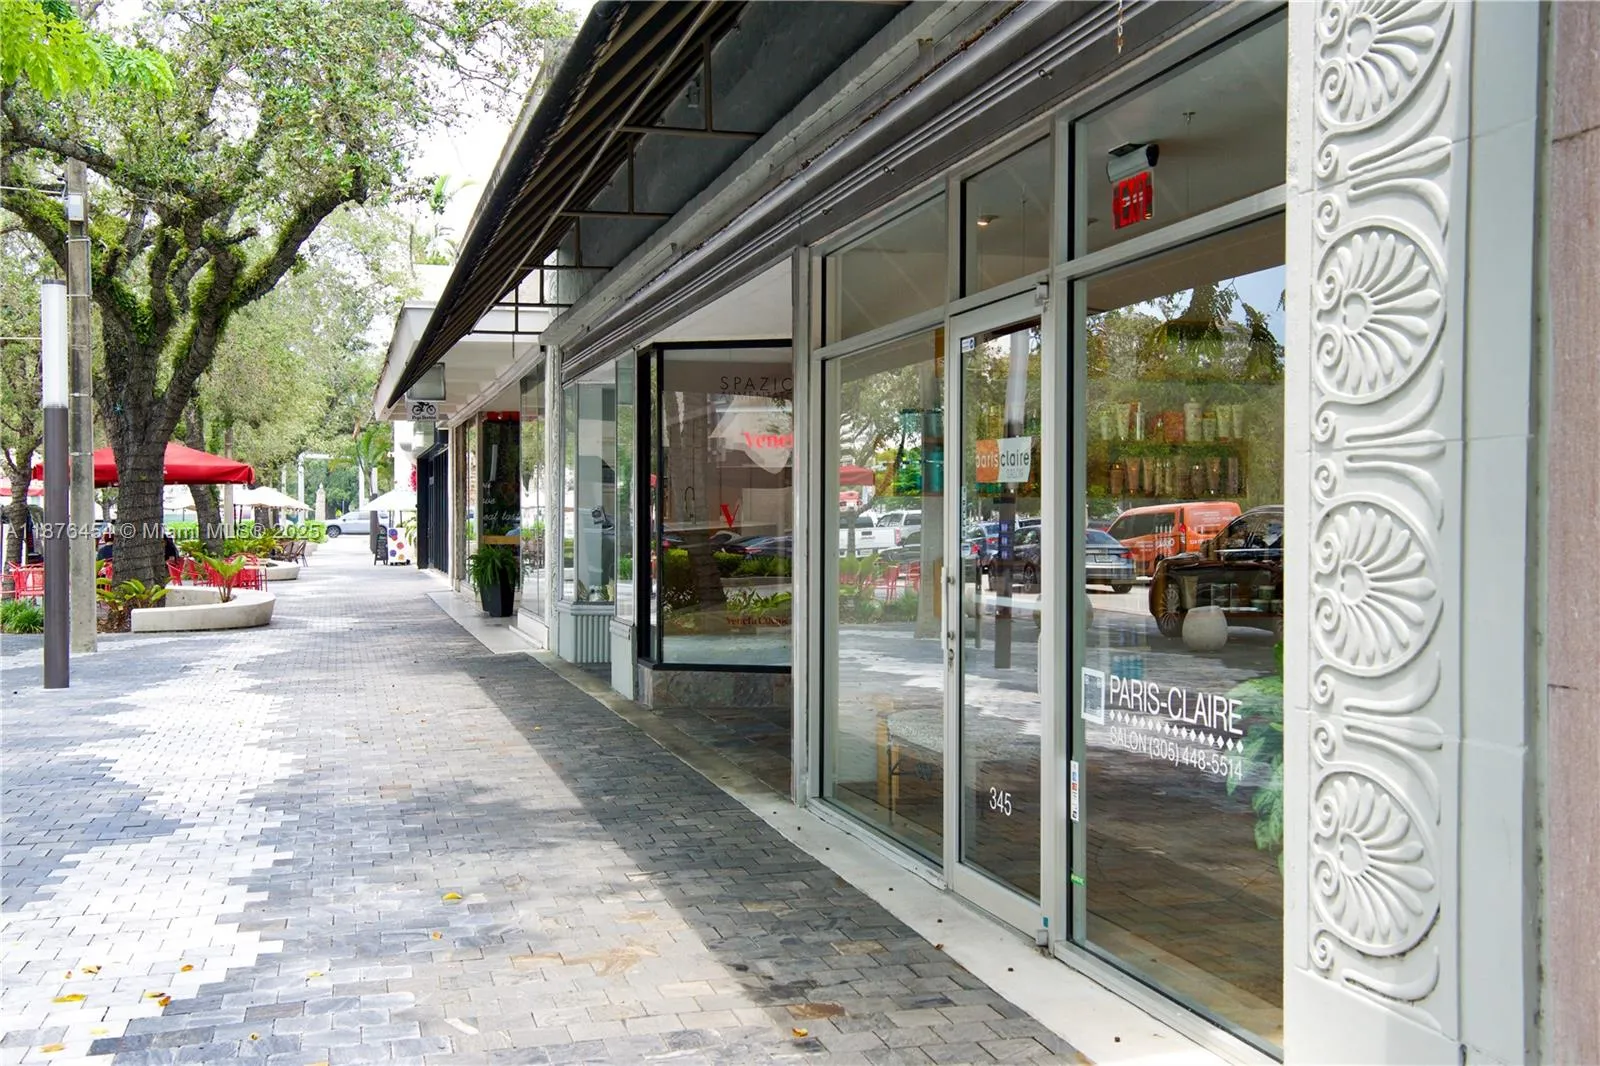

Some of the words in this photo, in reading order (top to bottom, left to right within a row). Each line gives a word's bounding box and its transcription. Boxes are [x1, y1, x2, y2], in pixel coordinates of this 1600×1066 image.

[1000, 448, 1030, 467] claire
[1109, 674, 1243, 735] PARIS-CLAIRE
[1111, 725, 1147, 752] SALON
[1149, 737, 1179, 767] (305)
[1182, 747, 1243, 781] 448-5514
[989, 786, 1012, 817] 345
